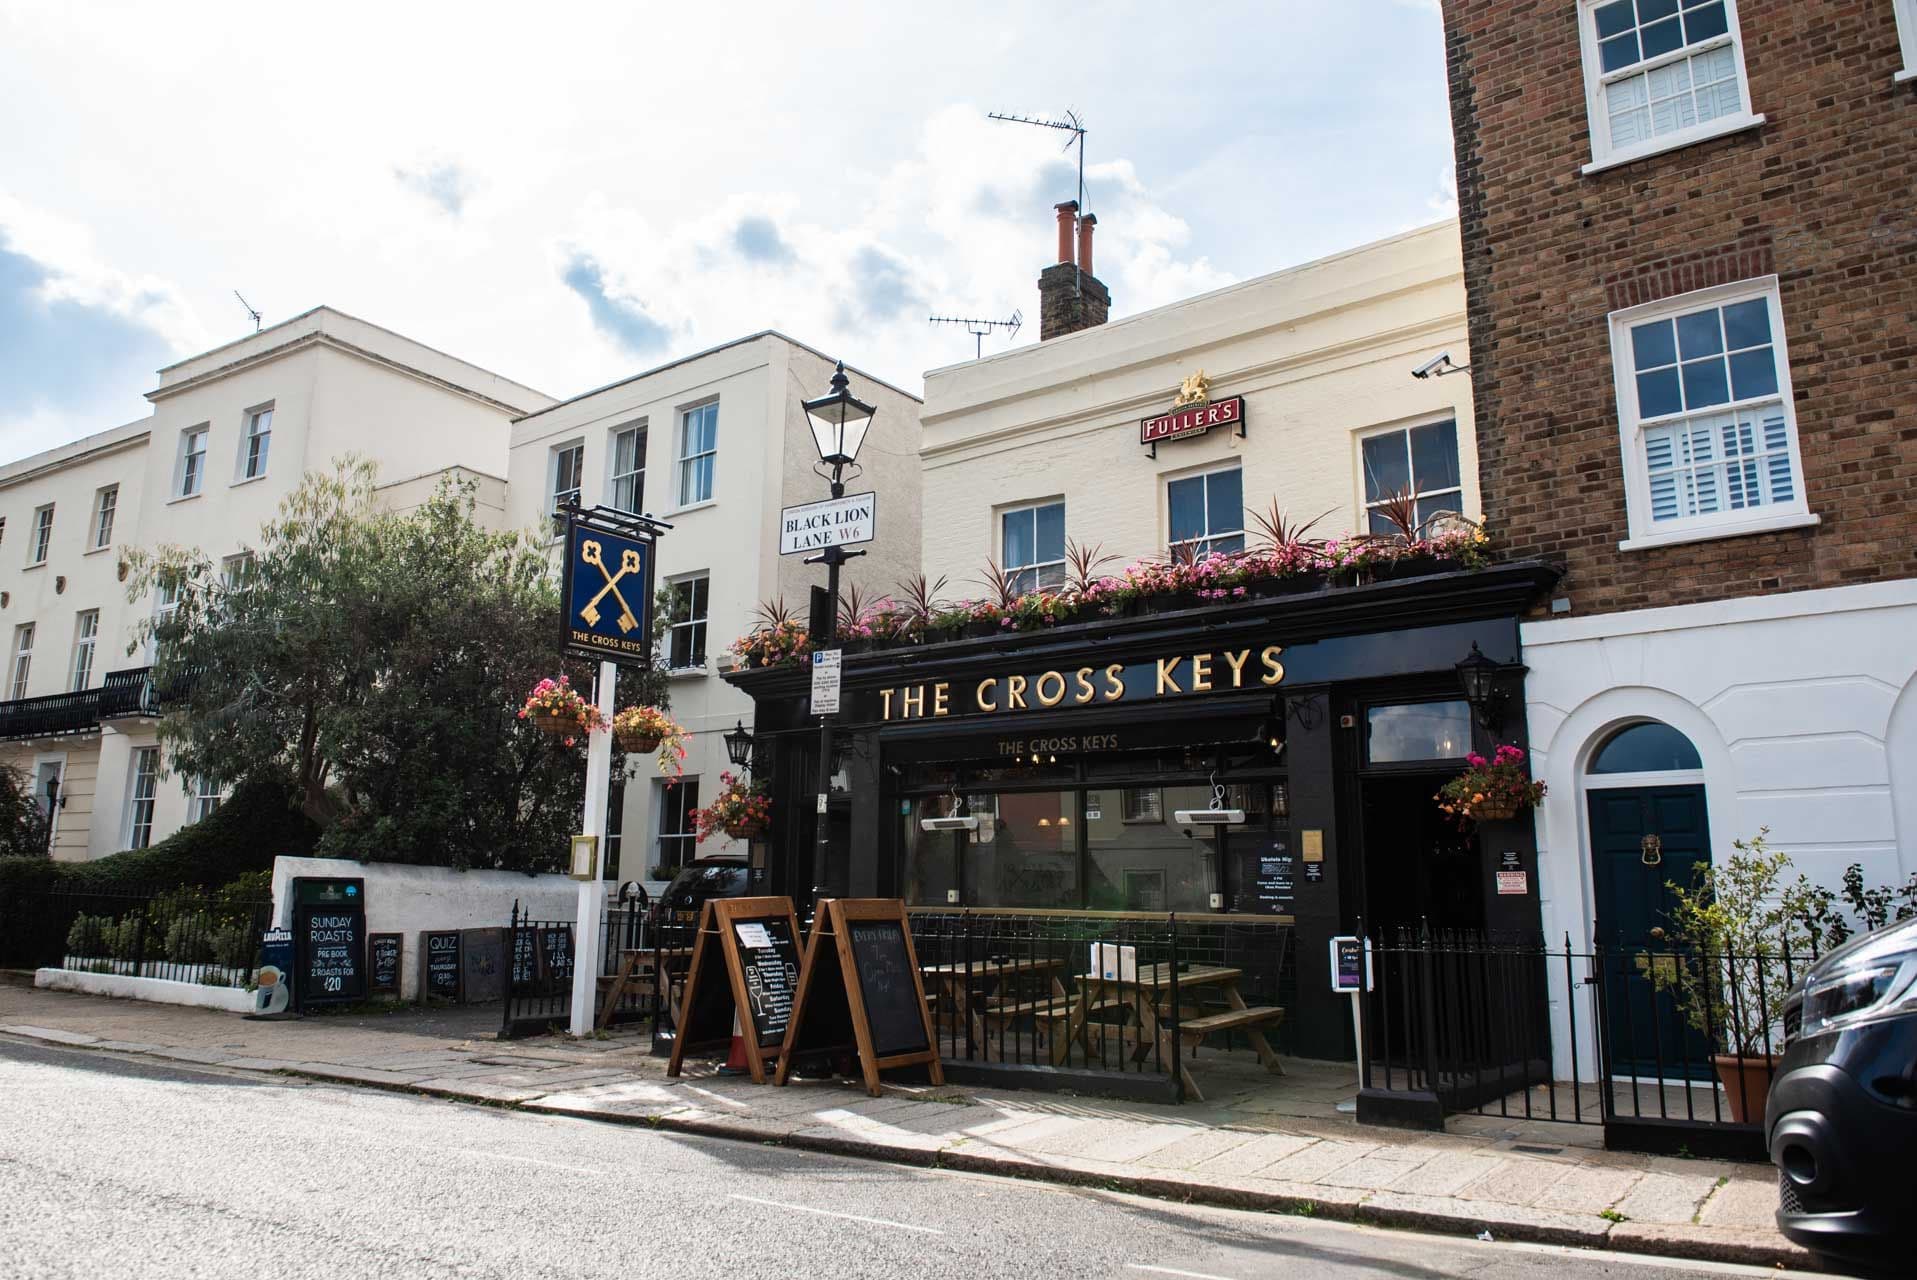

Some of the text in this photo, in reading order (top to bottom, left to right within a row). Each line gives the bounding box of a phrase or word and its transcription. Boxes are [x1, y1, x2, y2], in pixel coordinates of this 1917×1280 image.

[1146, 404, 1233, 437] FULLER'S
[786, 506, 870, 533] BLACK LION
[794, 527, 860, 549] LANE W6
[572, 631, 640, 652] THE CROSS KEYS
[879, 645, 1285, 720] THE CROSS KEYS
[999, 734, 1118, 754] THE CROSS KEYS
[311, 917, 352, 928] SUNDAY
[264, 928, 292, 942] LAVAZZA
[311, 931, 352, 942] ROASTS
[430, 936, 456, 950] QUIZ
[317, 968, 342, 976] ROASTS
